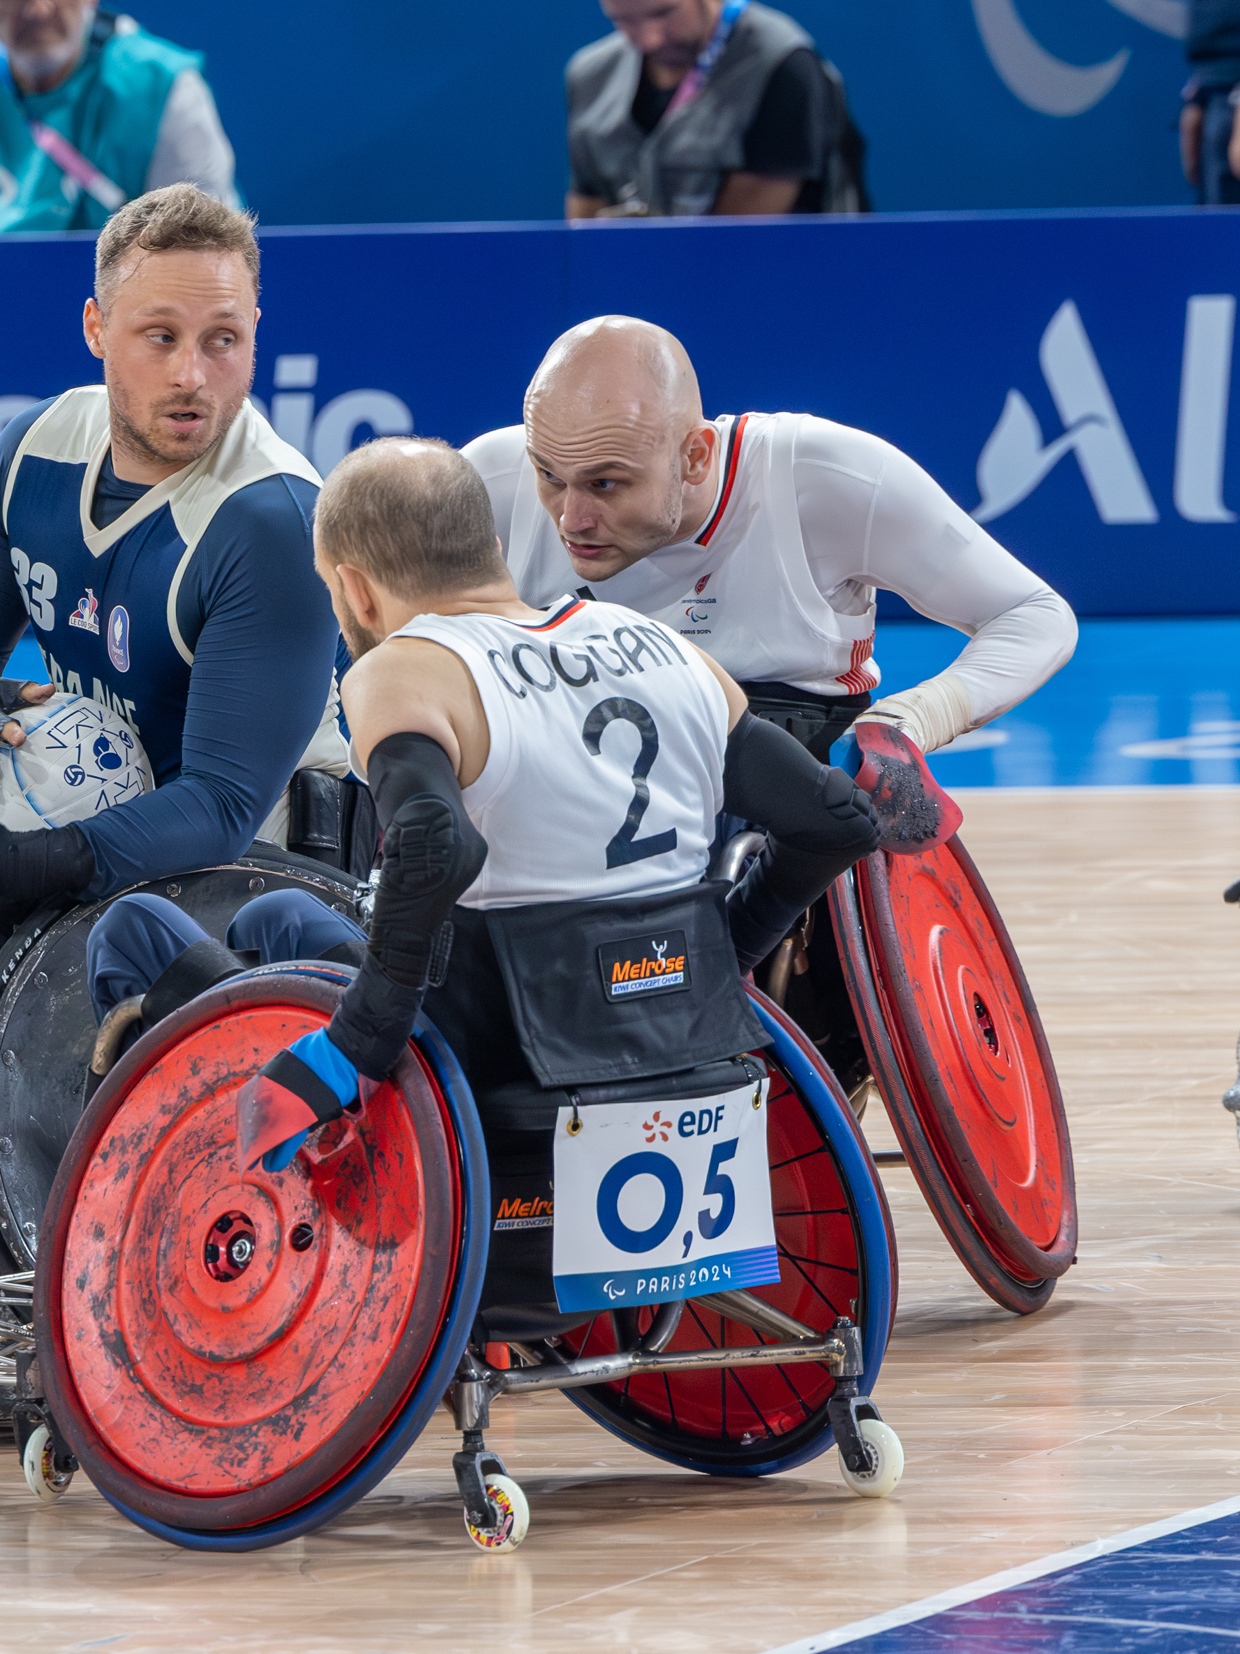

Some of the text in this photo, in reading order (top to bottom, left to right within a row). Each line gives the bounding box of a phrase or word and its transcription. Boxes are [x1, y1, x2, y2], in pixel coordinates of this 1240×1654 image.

[10, 546, 58, 632] 33
[486, 621, 688, 700] COGGAN
[581, 696, 678, 870] 2
[1, 927, 41, 984] KENDA
[612, 955, 685, 982] Melrose
[613, 984, 629, 993] KIWI
[630, 979, 660, 990] CONCEPT
[496, 1196, 554, 1218] Melro
[596, 1137, 739, 1259] 0,5
[689, 1264, 732, 1287] 2024
